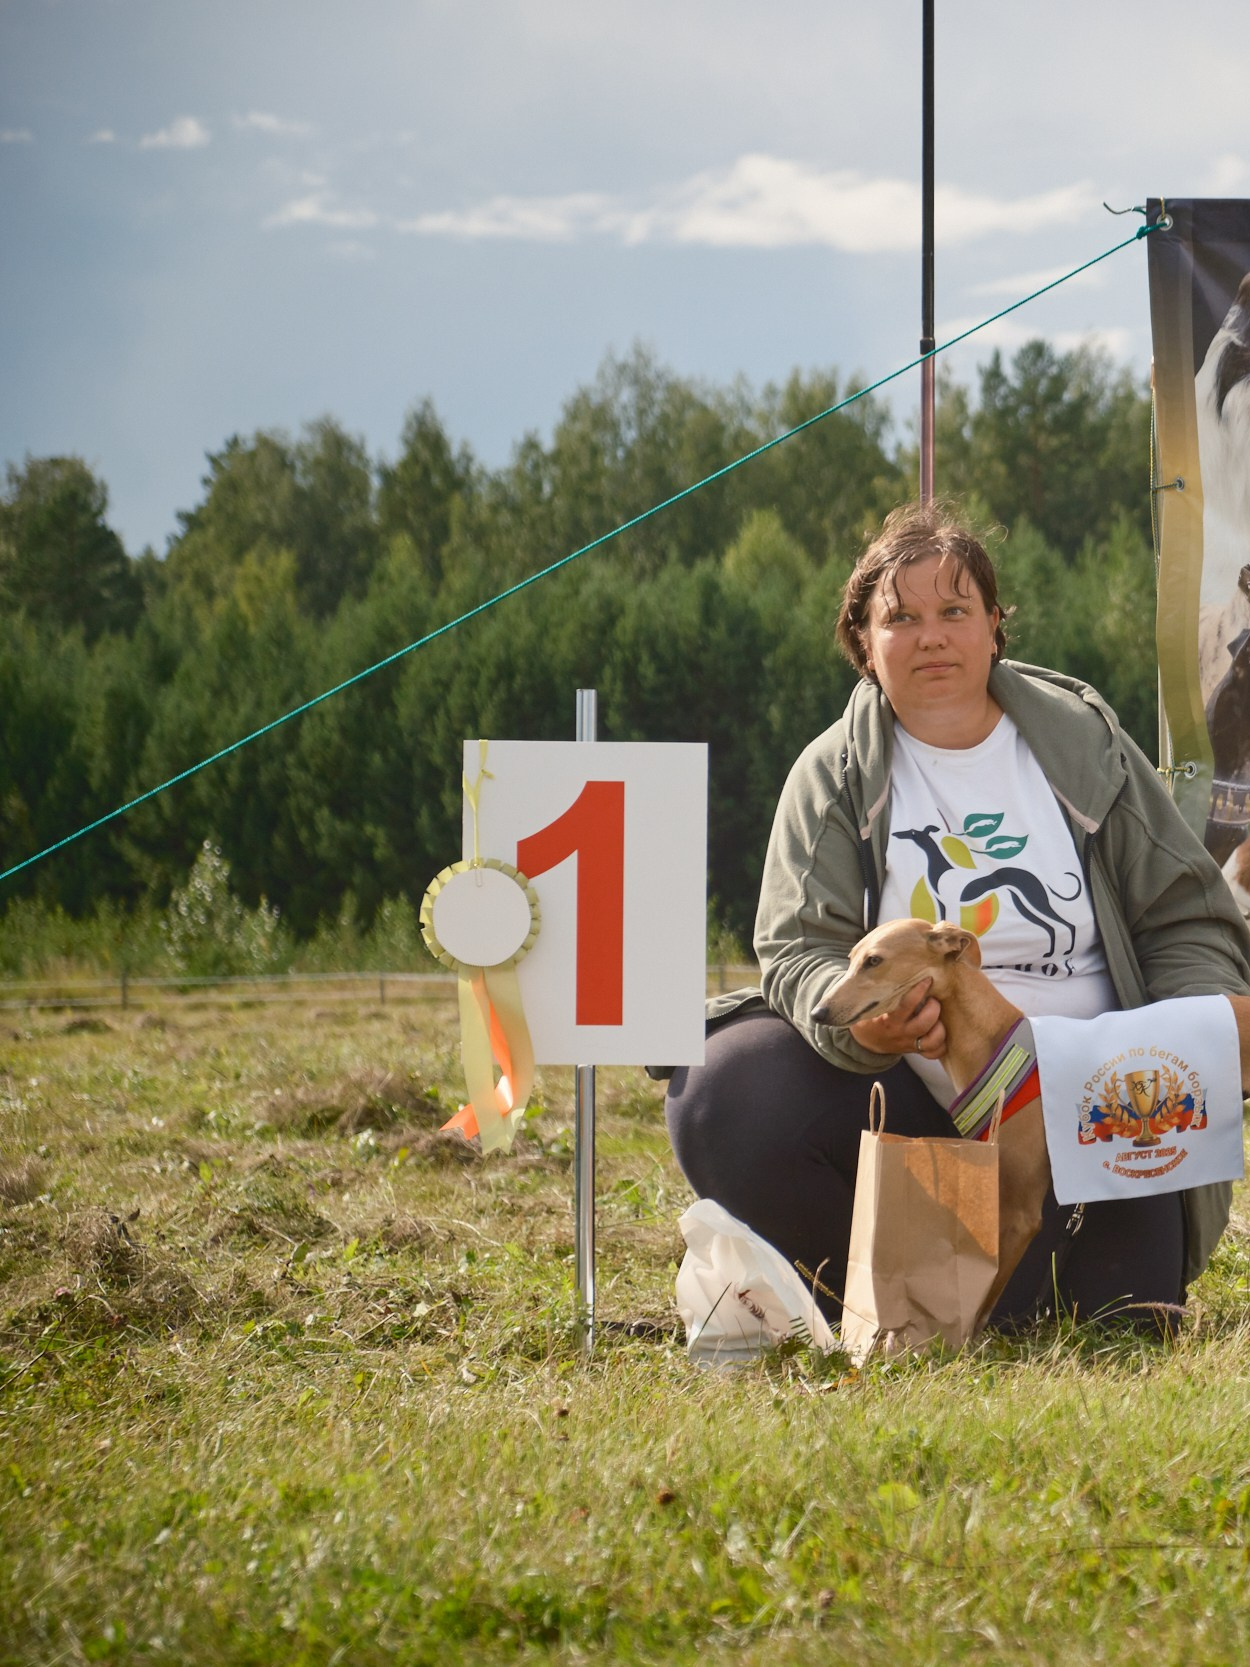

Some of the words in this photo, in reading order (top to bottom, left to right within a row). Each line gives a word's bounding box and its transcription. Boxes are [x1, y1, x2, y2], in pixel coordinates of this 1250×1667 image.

[516, 780, 625, 1026] 1
[1083, 1052, 1125, 1093] России
[1128, 1047, 1145, 1057] по
[1149, 1045, 1189, 1072] бегам
